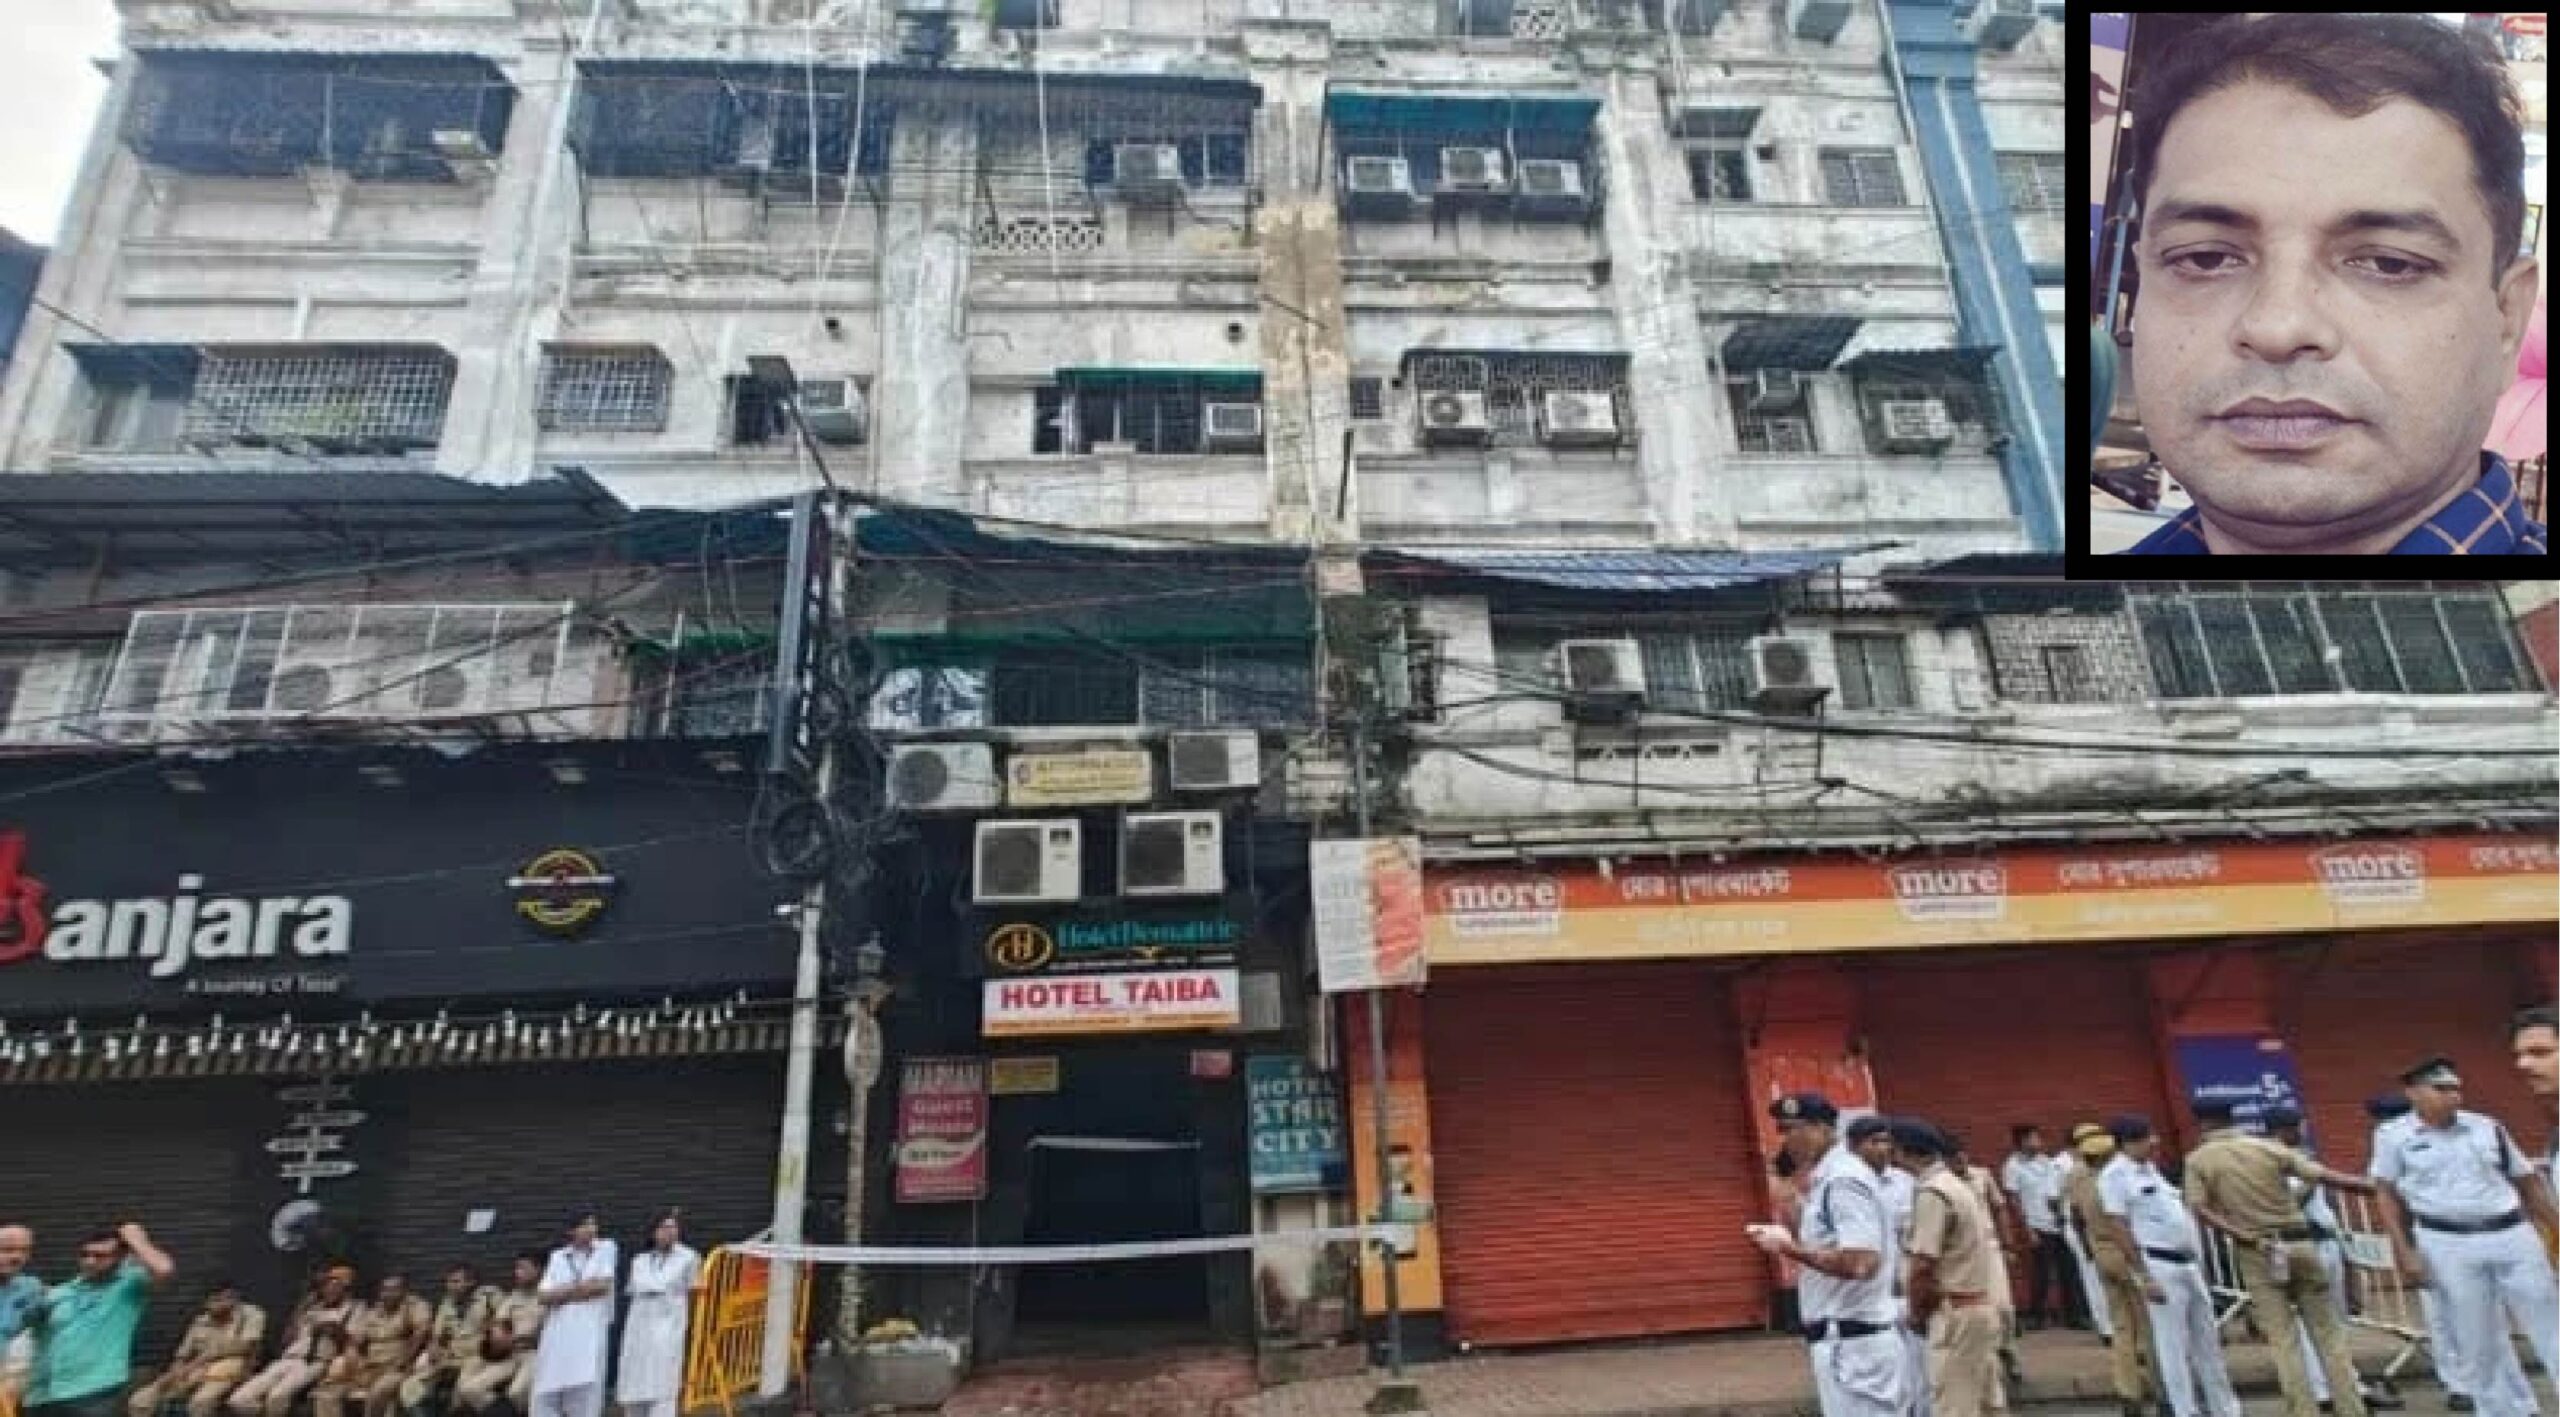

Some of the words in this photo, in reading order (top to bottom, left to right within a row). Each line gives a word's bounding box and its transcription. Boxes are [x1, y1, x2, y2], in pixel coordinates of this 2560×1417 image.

[2322, 854, 2416, 878] more
[1901, 868, 1998, 894] more
[1452, 883, 1556, 909] more
[1001, 983, 1110, 1009] HOTEL
[1124, 976, 1221, 1004] TAIBA
[1253, 1099, 1337, 1125] STAR
[1254, 1129, 1335, 1153] CITY
